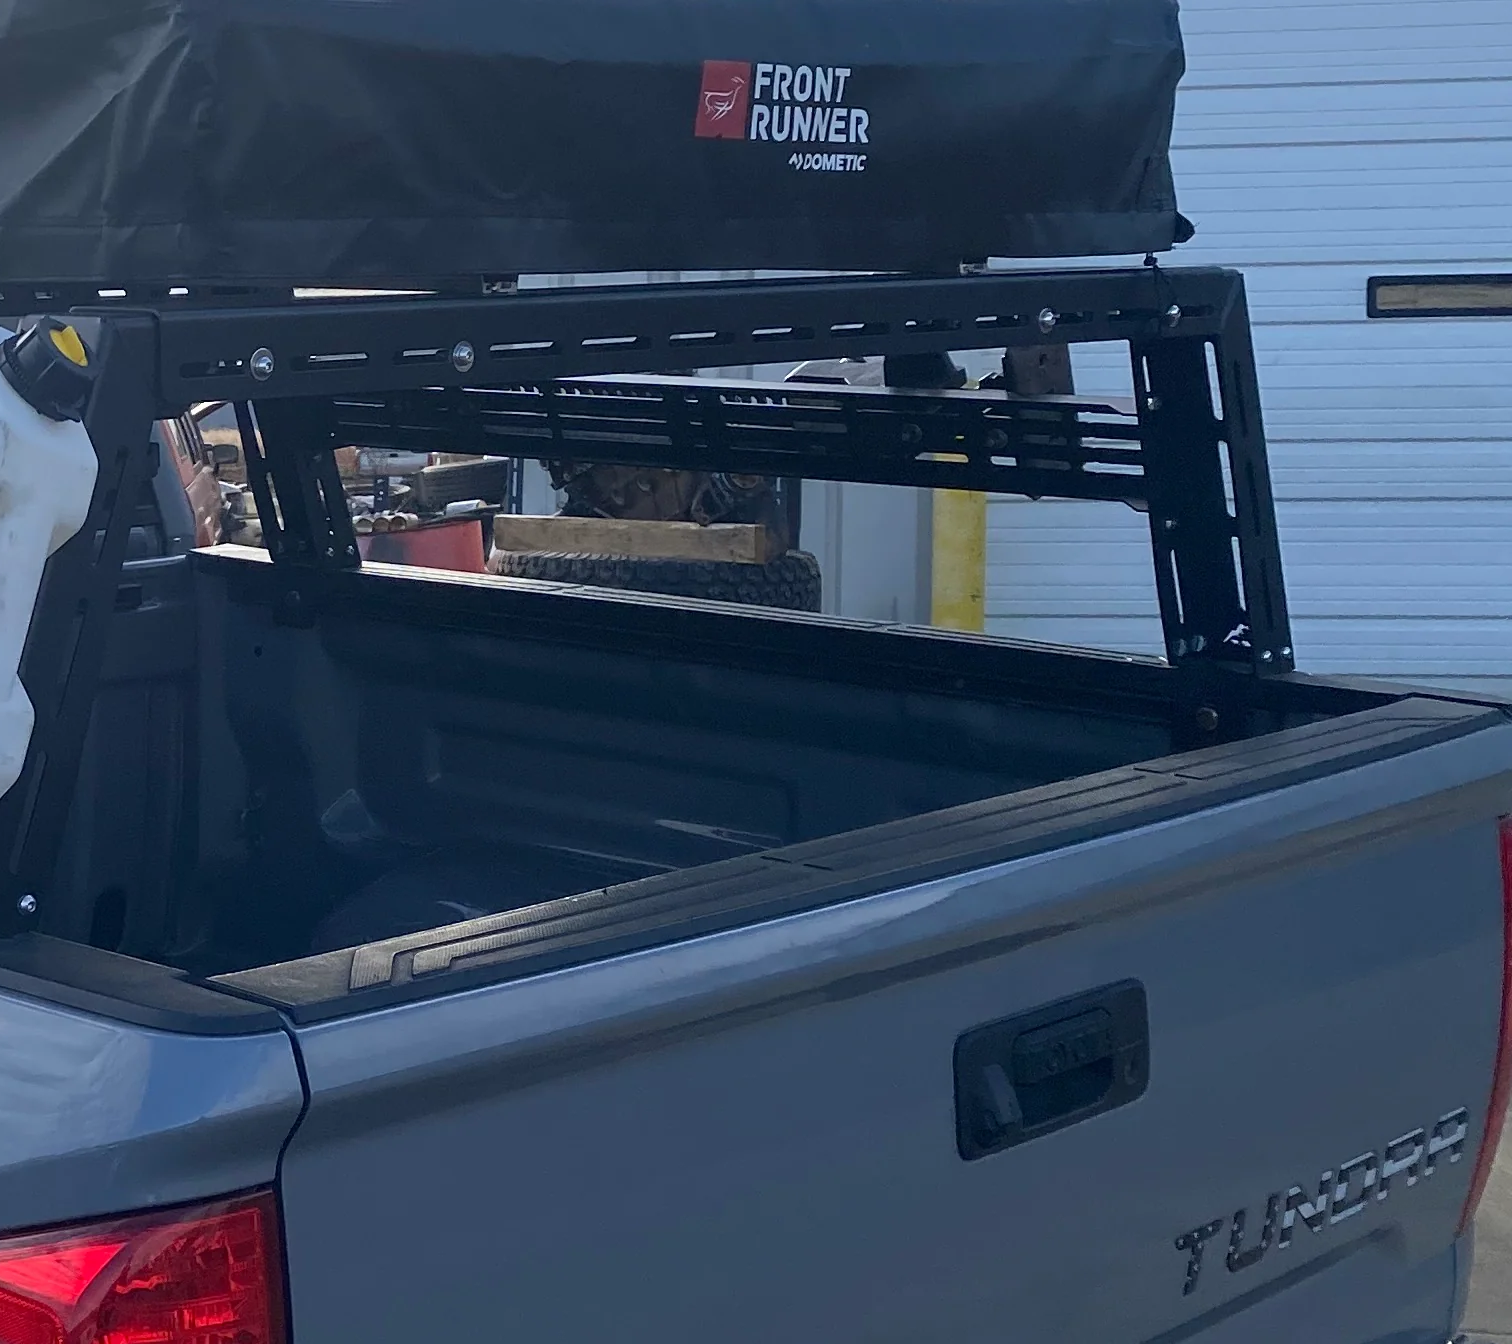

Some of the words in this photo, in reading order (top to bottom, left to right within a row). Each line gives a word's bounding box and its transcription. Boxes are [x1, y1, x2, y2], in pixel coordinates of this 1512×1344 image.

[753, 62, 851, 103] FRONT
[750, 104, 869, 143] RUNNER
[802, 153, 867, 172] DOMETIC
[1174, 1106, 1469, 1297] TUNDRA
